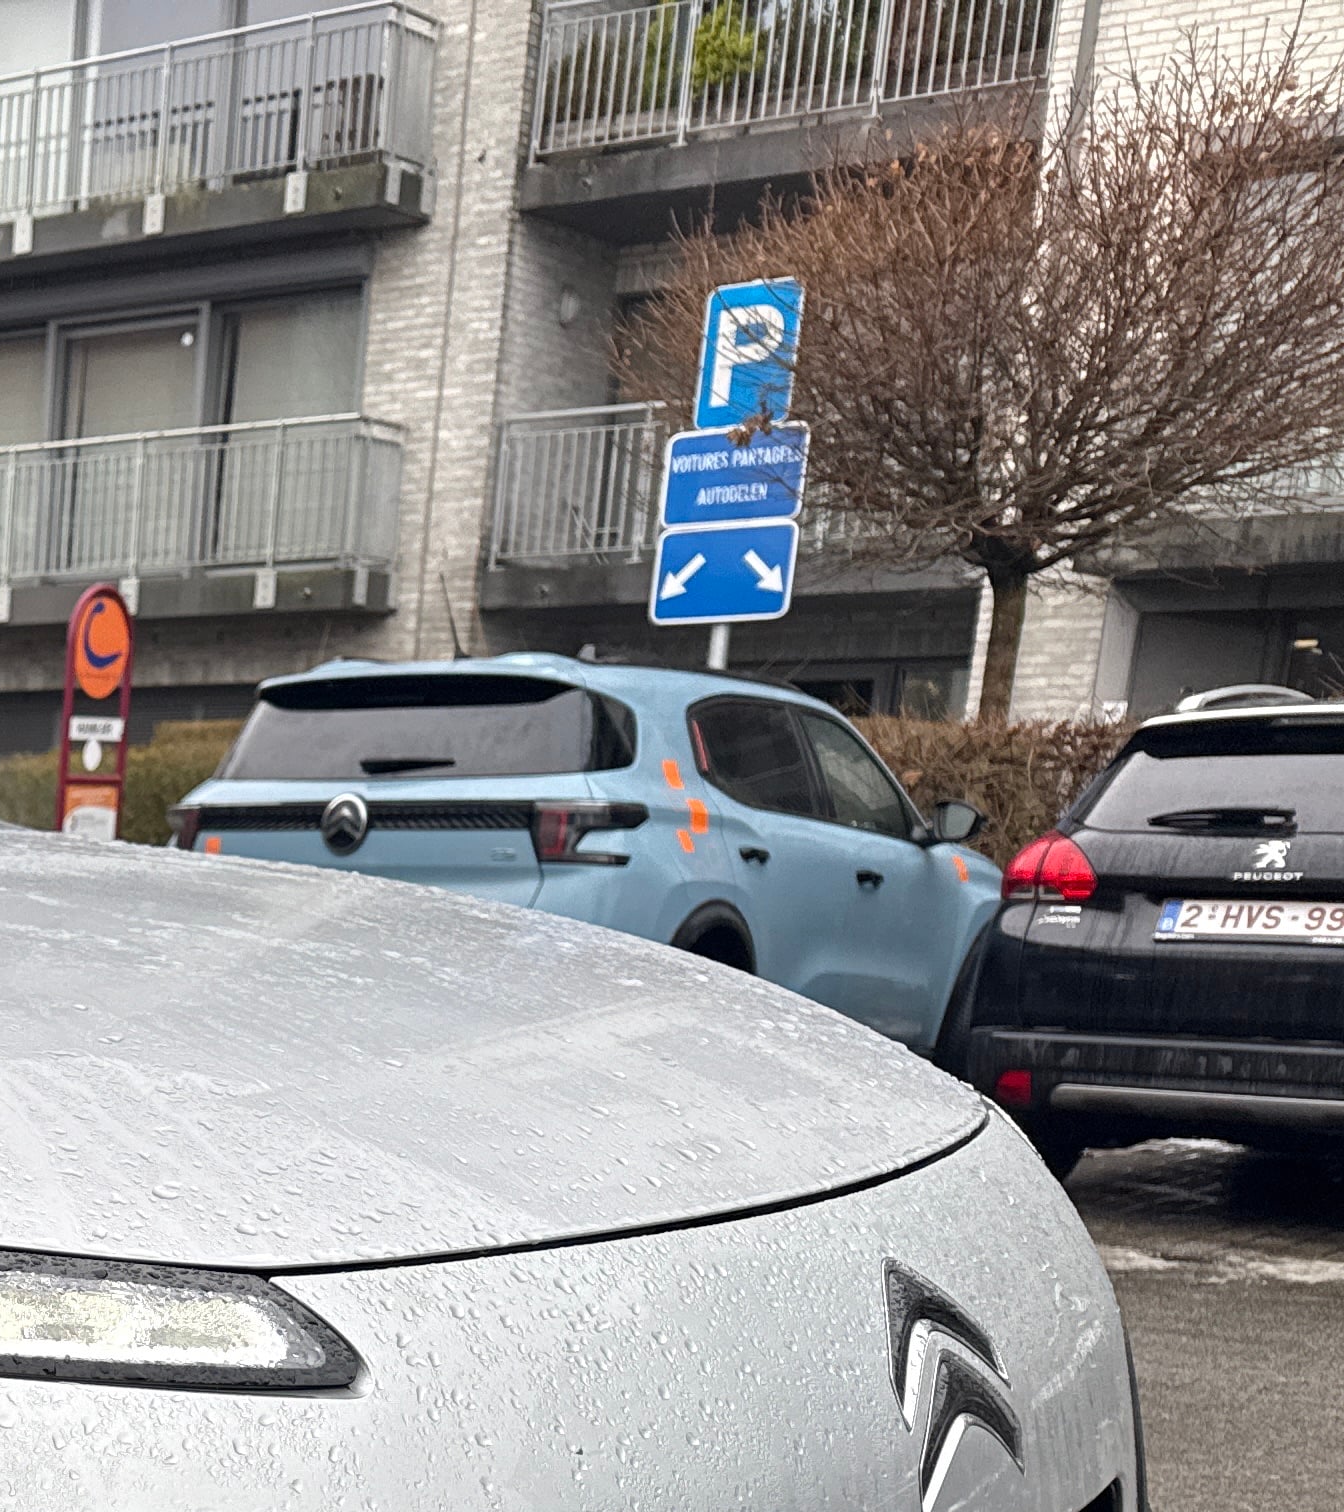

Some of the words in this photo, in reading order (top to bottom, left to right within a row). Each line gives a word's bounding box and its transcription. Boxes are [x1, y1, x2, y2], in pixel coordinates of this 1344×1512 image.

[710, 304, 785, 407] P
[672, 450, 729, 473] VOITURES
[696, 482, 769, 506] AUTODELEN
[1233, 871, 1304, 881] PEUGEOT
